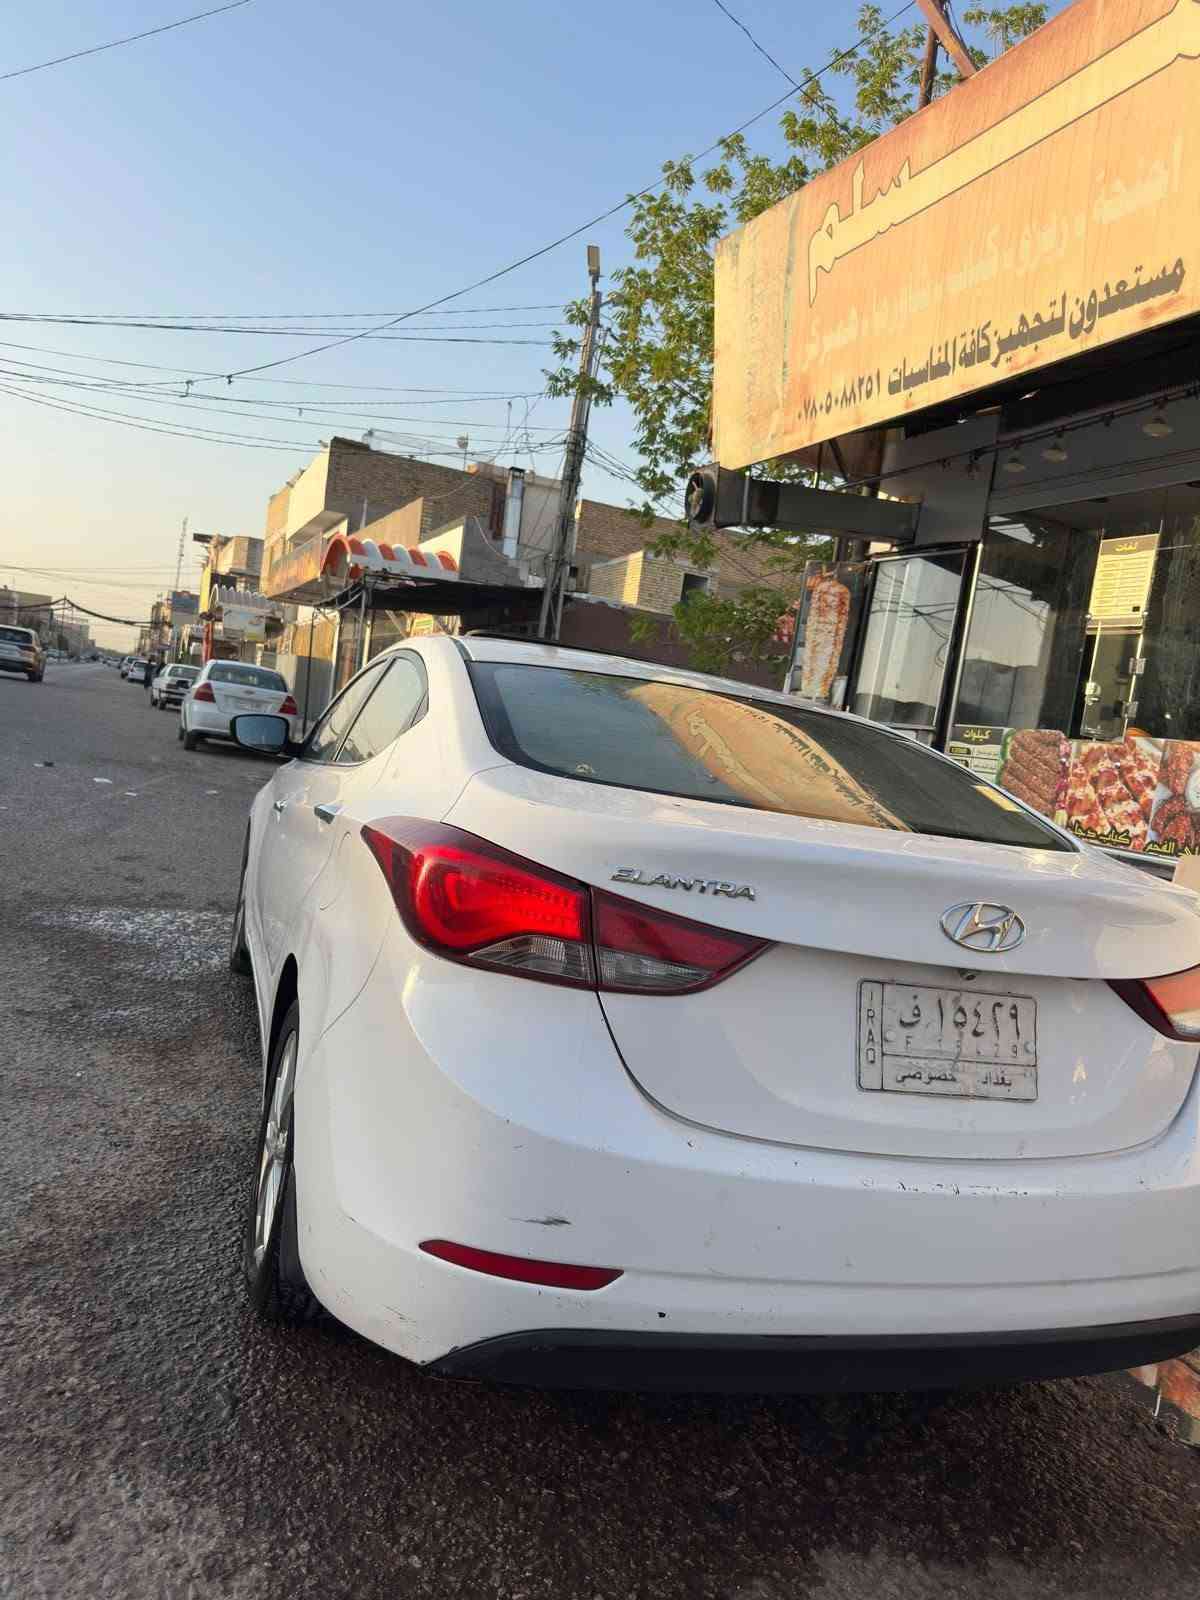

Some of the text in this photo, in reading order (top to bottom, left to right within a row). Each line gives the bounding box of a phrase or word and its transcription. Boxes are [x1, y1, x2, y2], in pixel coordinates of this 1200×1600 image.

[990, 290, 1066, 369] لتجهيز
[1069, 257, 1186, 339] مستعدون
[887, 336, 957, 402] المناسبات
[958, 320, 992, 369] كافة
[610, 866, 757, 901] ELANTRA
